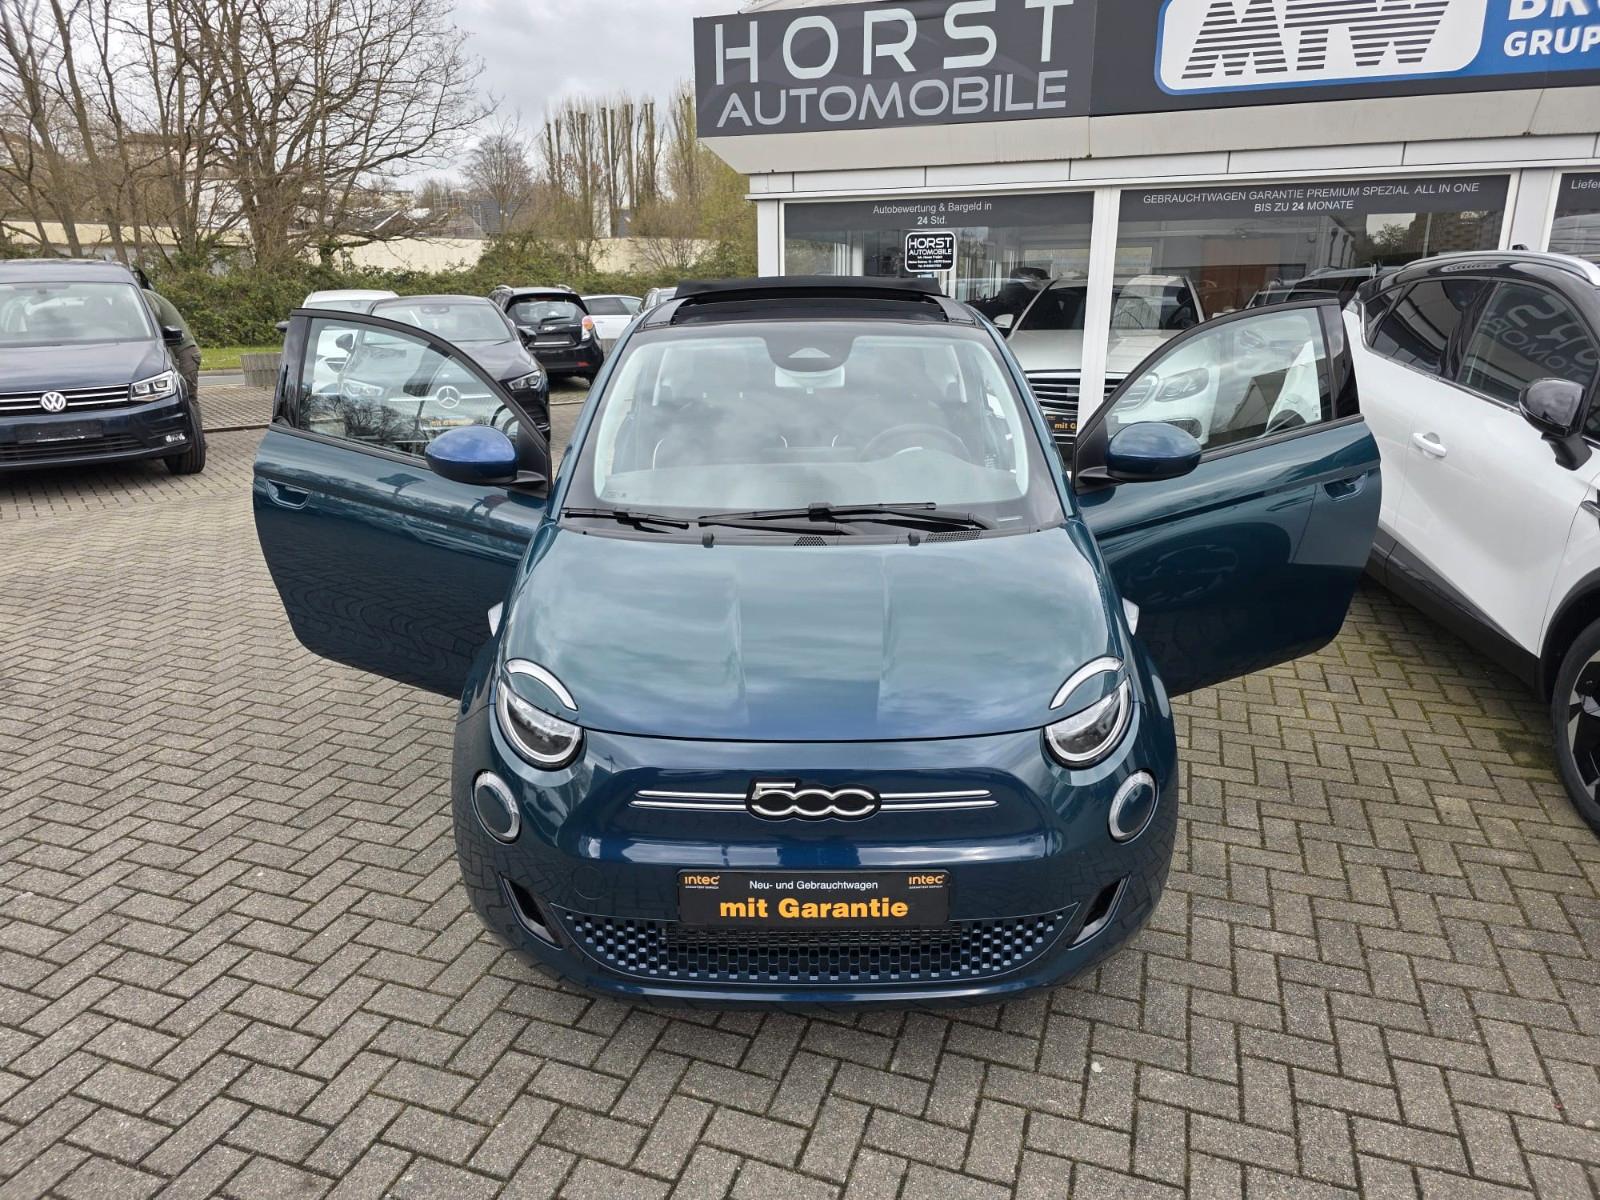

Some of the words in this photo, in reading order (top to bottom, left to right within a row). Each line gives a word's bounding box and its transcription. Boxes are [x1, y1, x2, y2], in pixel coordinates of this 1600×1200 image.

[715, 0, 1074, 85] HORST
[1503, 25, 1600, 57] GRUP
[716, 69, 1068, 128] AUTOMOBILE
[1571, 179, 1600, 190] Liefe
[1143, 191, 1246, 204] GEBRAUCHTWAGEN
[1249, 188, 1304, 200] GARANTIE
[1306, 186, 1360, 198] PREMIUM
[1362, 184, 1409, 196] SPEZIAL
[1414, 184, 1435, 194] ALL
[1438, 183, 1451, 193] IN
[1453, 182, 1480, 193] ONE
[873, 204, 937, 214] Autobewertung
[939, 202, 946, 212] &
[948, 202, 982, 213] Bargeld
[984, 202, 992, 210] in
[1254, 203, 1272, 212] BIS
[1274, 202, 1290, 212] ZU
[1291, 202, 1304, 211] 24
[1307, 200, 1354, 211] MONATE
[917, 215, 928, 225] 24
[930, 215, 947, 225] Std.
[908, 237, 953, 249] HORST
[908, 248, 953, 256] AUTOMOBILE
[751, 782, 875, 816] 500
[684, 875, 720, 885] intec
[749, 880, 773, 890] Neu-
[775, 880, 794, 890] und
[796, 881, 879, 891] Gebrauchtwagen
[908, 874, 945, 885] intec
[720, 897, 768, 917] mit
[778, 897, 908, 918] Garantie
